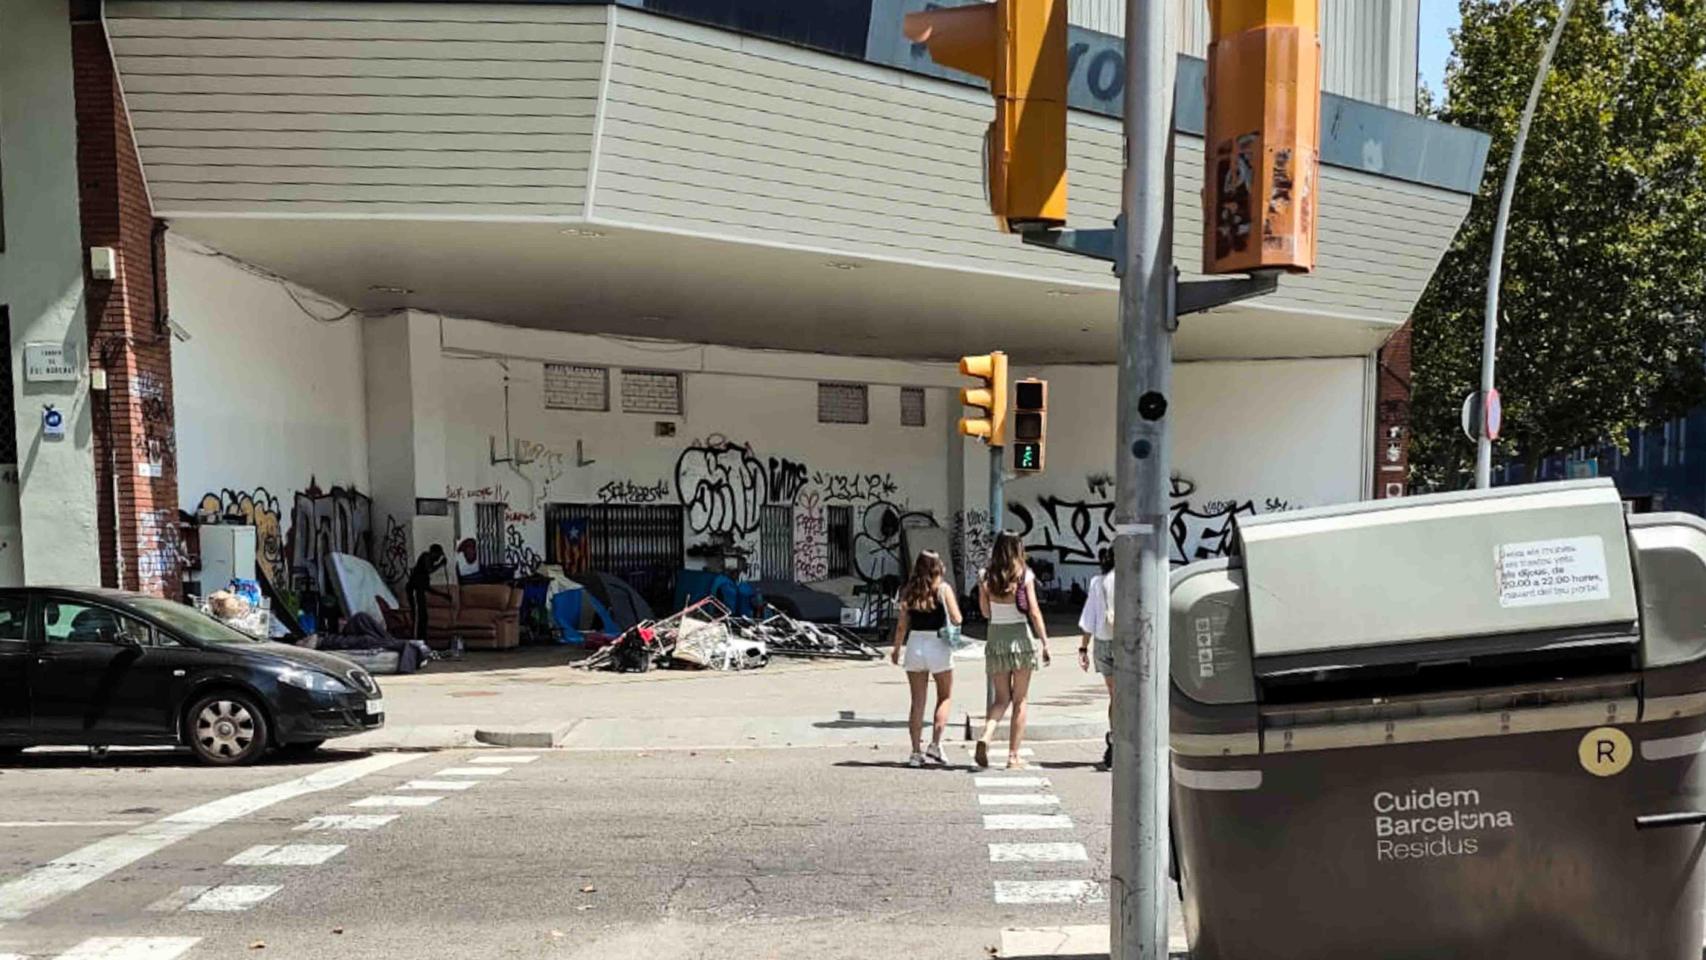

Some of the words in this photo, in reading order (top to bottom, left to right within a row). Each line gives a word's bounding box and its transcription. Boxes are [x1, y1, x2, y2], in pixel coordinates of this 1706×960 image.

[1597, 740, 1615, 763] R
[1373, 788, 1480, 813] Cuidem
[1375, 809, 1513, 837] Barcelona
[1376, 834, 1479, 862] Residus
